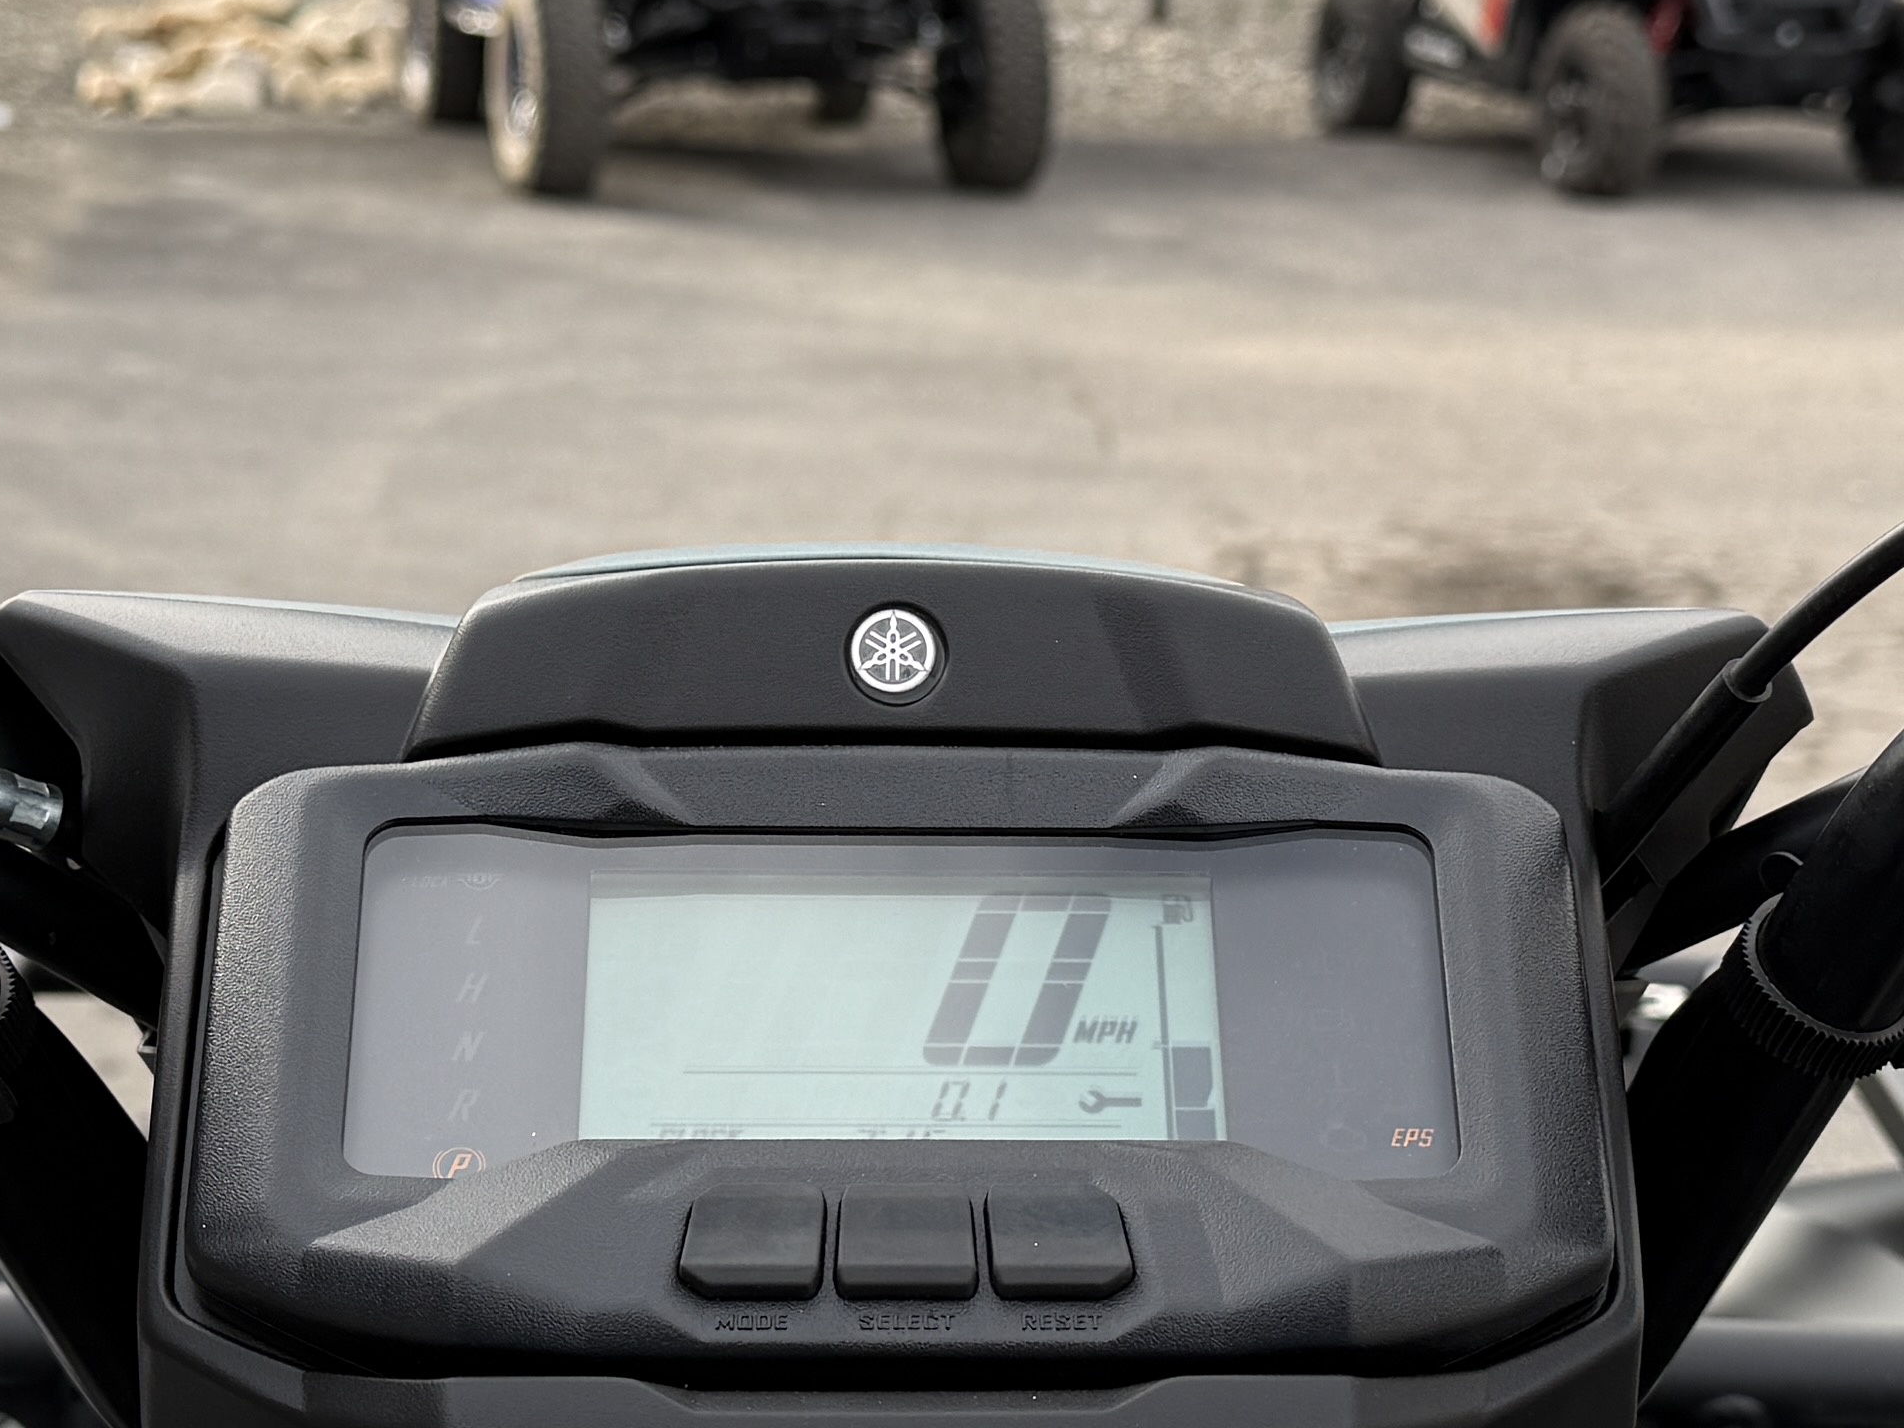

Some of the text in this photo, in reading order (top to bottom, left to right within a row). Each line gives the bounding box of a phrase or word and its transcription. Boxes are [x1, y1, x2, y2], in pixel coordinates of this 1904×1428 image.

[922, 893, 1137, 1067] 0 MPH
[1391, 1128, 1434, 1147] EPS
[715, 1314, 1103, 1331] MODE SELECT RESET
